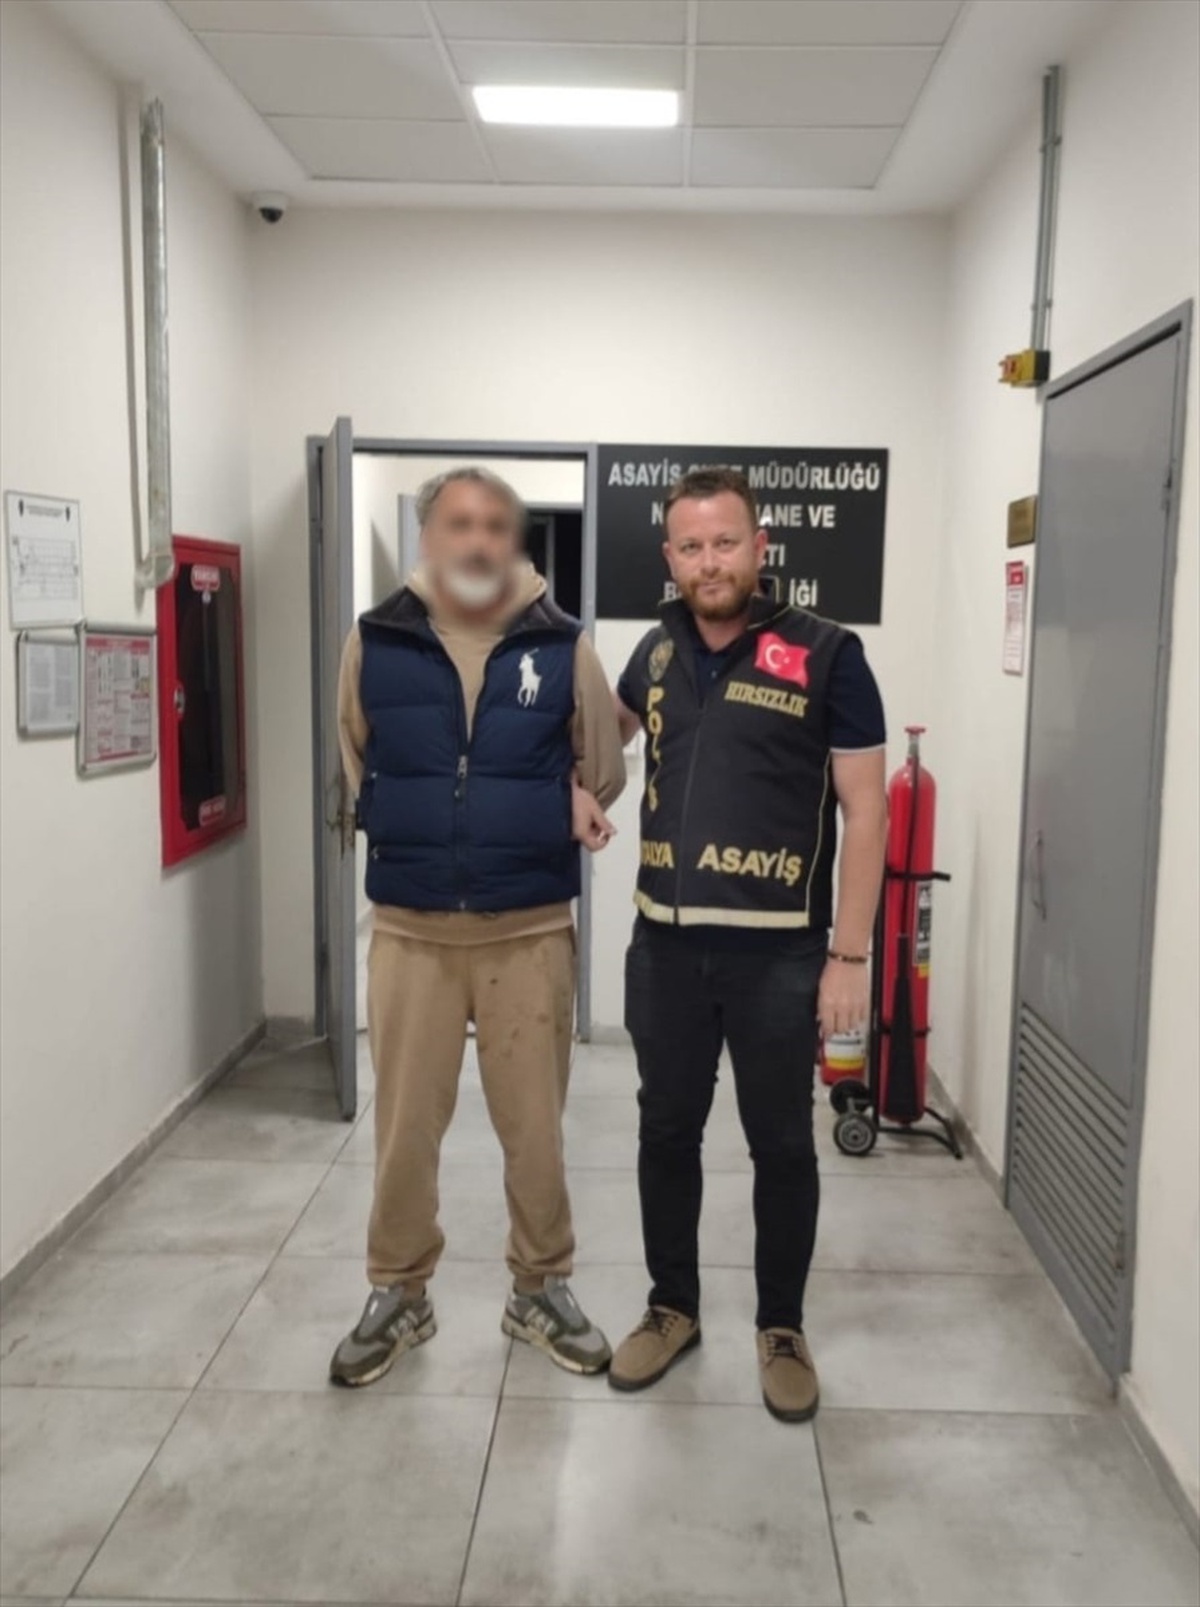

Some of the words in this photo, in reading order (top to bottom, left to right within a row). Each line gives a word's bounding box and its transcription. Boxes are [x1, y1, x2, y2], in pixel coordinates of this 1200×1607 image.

[749, 462, 880, 491] MÜDÜRLÜĞÜ
[808, 506, 836, 528] VE
[724, 681, 808, 718] HIRSIZLIK
[697, 844, 803, 886] ASAYİŞ
